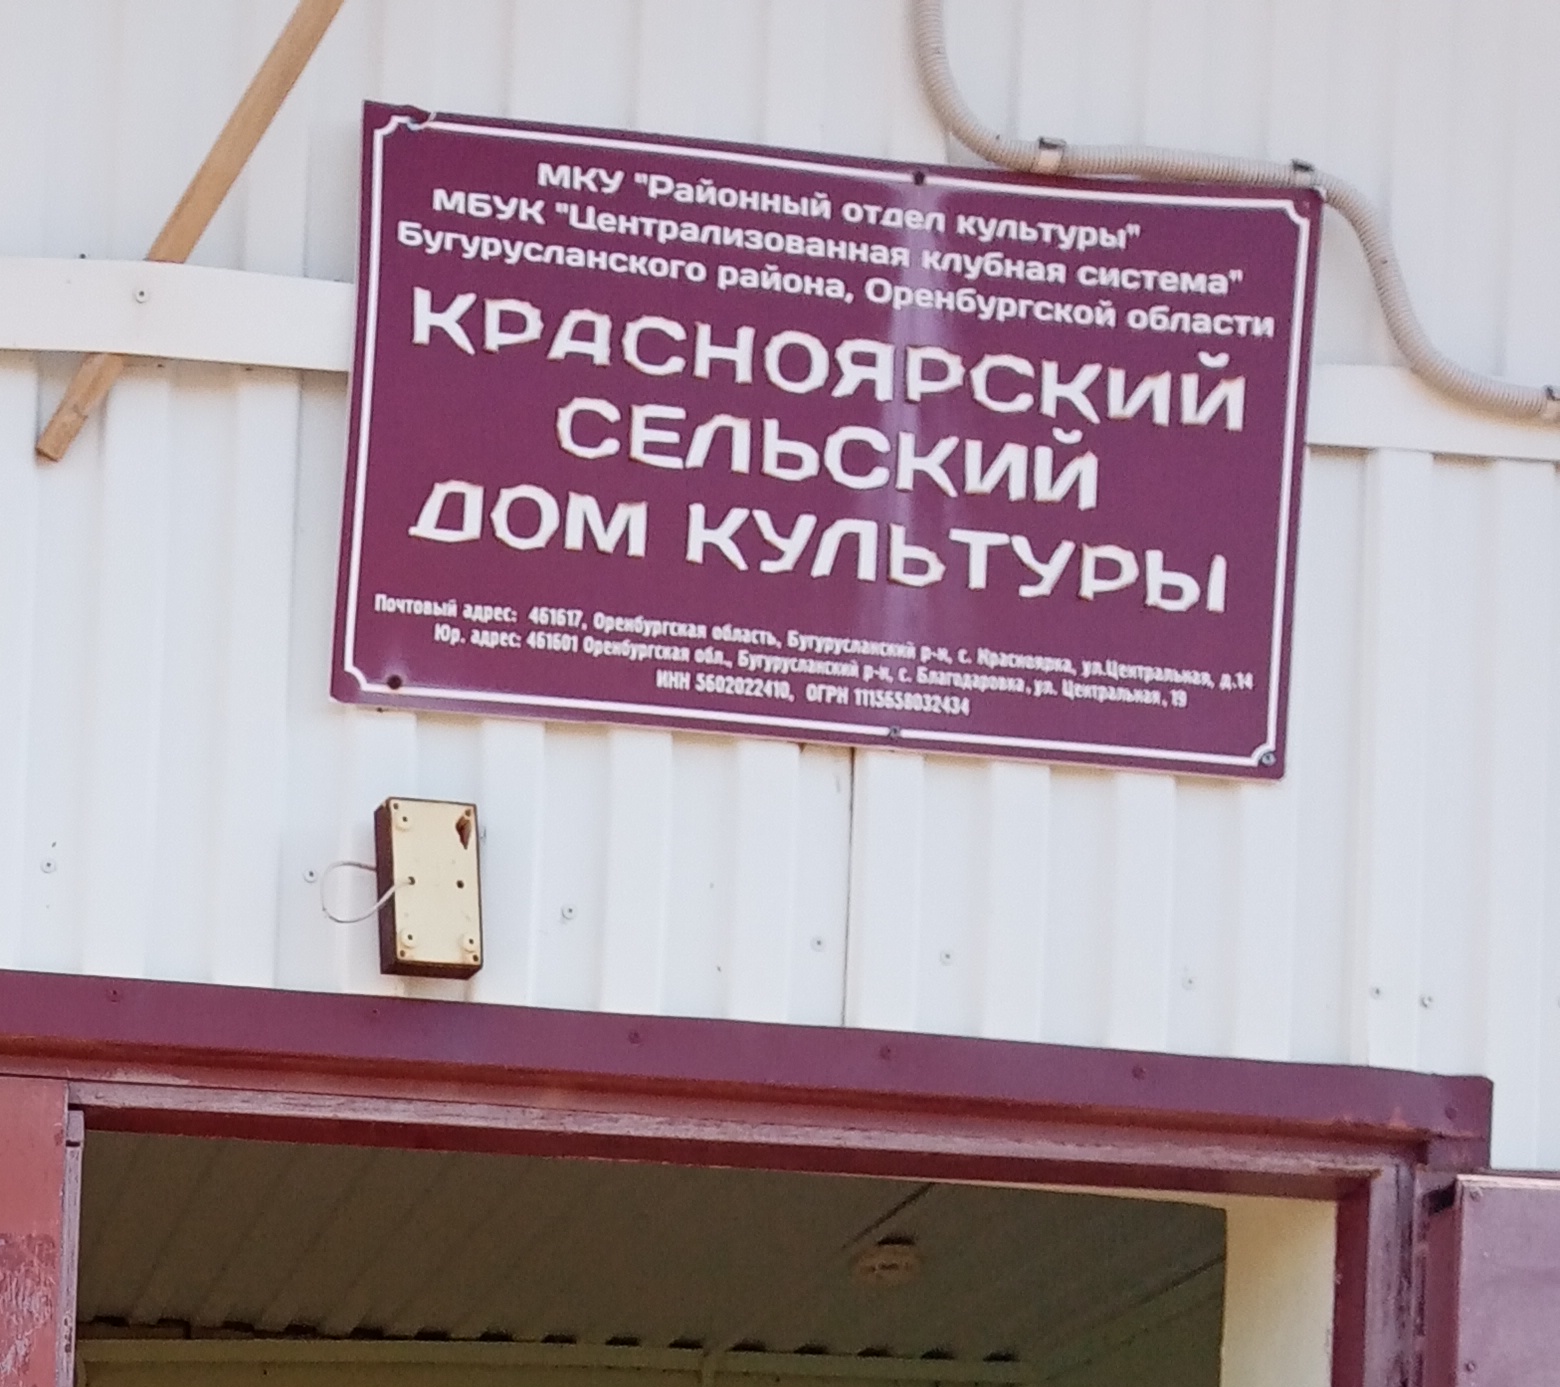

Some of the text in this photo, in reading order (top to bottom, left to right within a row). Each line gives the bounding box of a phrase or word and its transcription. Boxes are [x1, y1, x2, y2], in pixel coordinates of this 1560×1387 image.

[433, 189, 1243, 294] МБУК "Централизованная клубная система"
[538, 163, 1140, 250] МКУ "Районный отдел культуры"
[398, 221, 1274, 337] Бугурусланского района, Оренбургской области
[413, 287, 1245, 431] КРАСНОЯРСКИЙ
[557, 398, 1097, 510] СЕЛЬСКИЙ
[409, 480, 1226, 612] ДОМ КУЛЬТУРЫ
[375, 594, 457, 616] Почтовый
[463, 604, 517, 622] адрес:
[593, 612, 706, 638] Оренбургская
[712, 624, 781, 648] область,
[787, 630, 915, 658] Бугурусланский
[921, 646, 952, 663] р-н,
[958, 649, 971, 663] с.
[656, 670, 690, 690] ИНН
[806, 684, 848, 704] ОГРН
